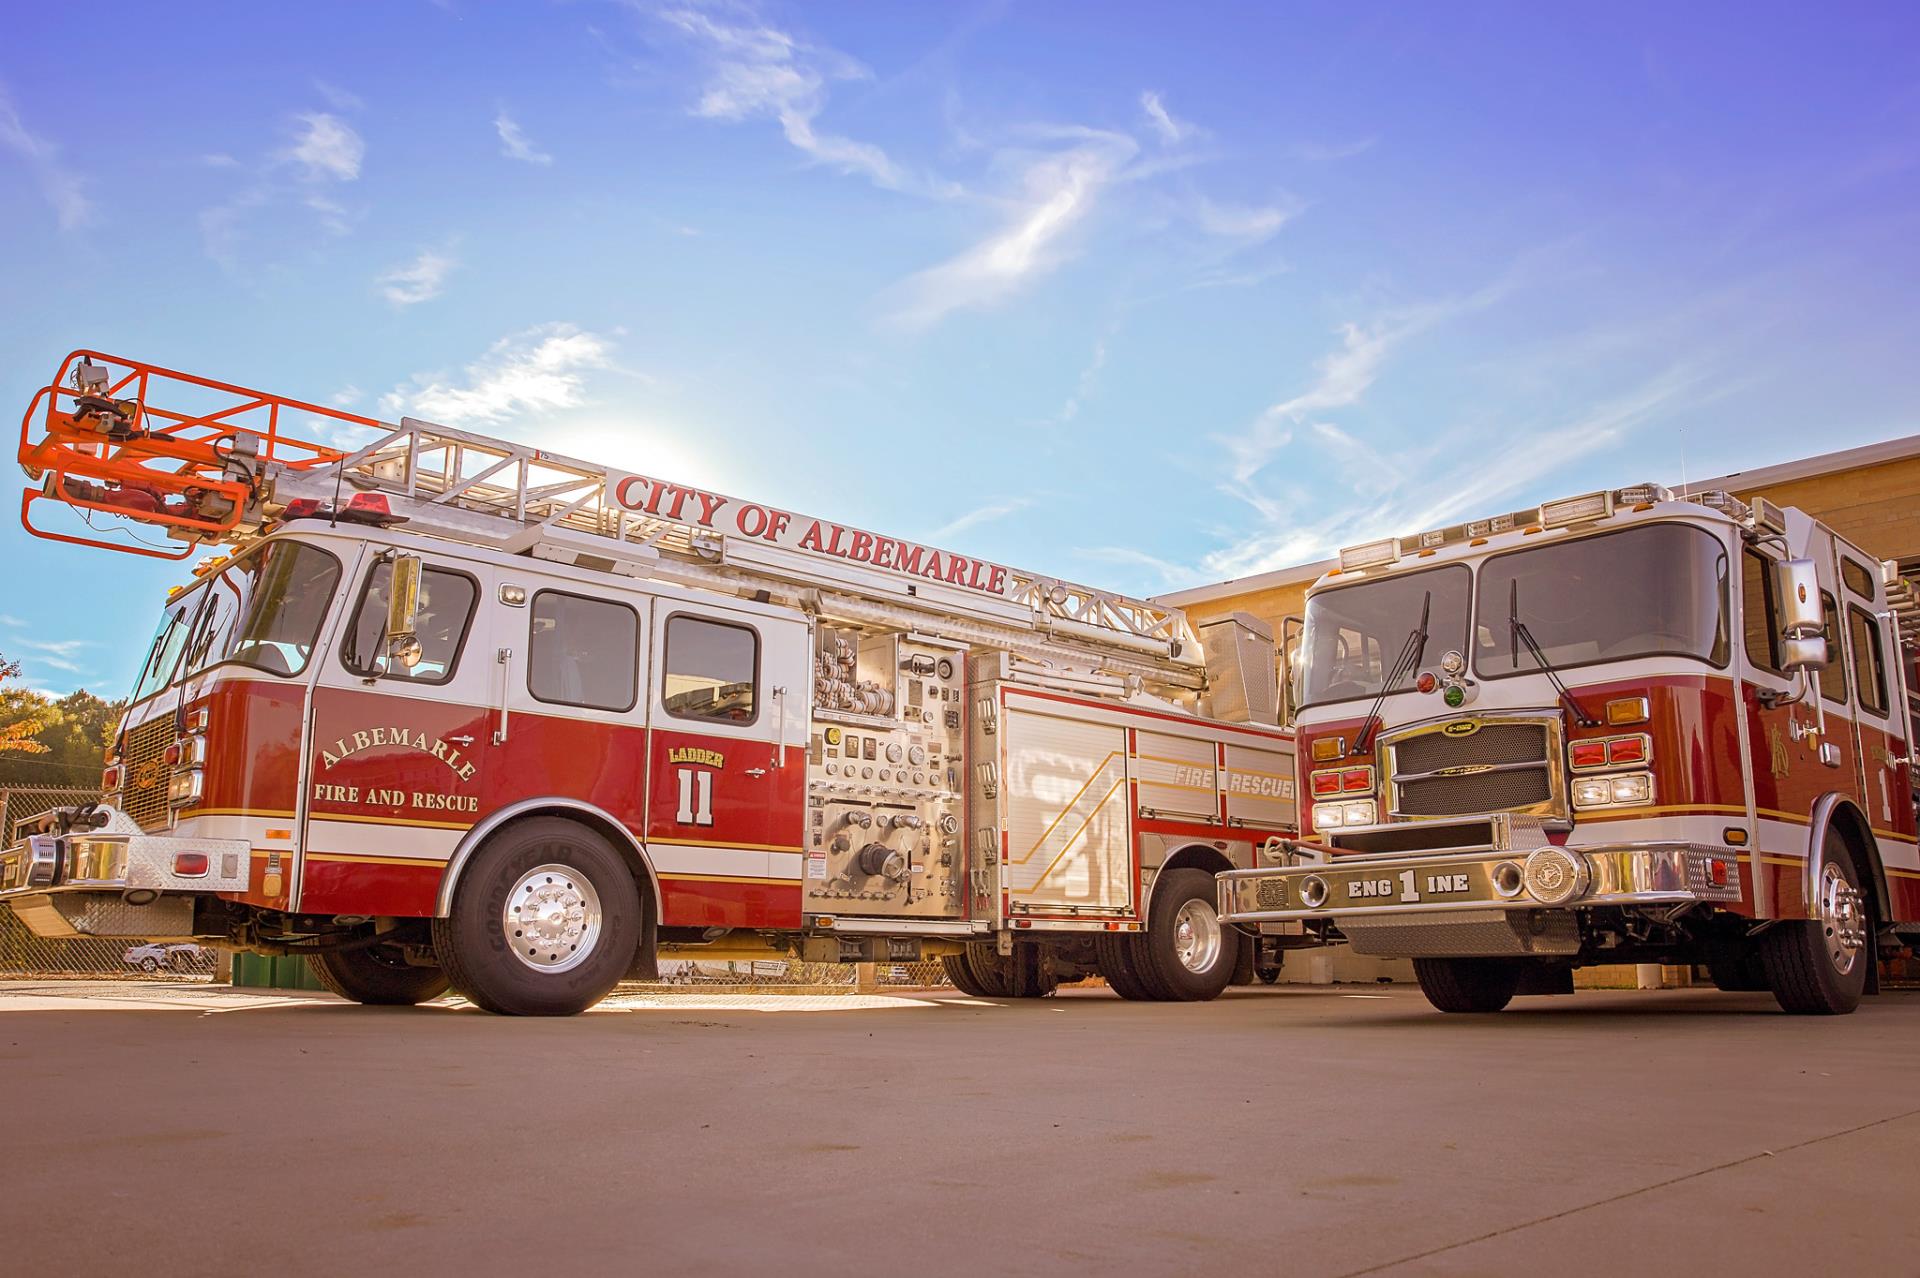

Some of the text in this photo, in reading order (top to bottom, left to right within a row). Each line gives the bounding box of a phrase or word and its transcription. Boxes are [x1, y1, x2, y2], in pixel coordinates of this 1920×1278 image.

[615, 476, 1008, 595] CITY OF ALBEMARLE
[320, 727, 477, 782] ALBEMARLE
[668, 747, 724, 769] LADDER
[314, 784, 478, 812] FIRE AND RESCUE
[676, 768, 713, 826] 11
[1175, 766, 1292, 799] FIRE RESCUE
[1878, 768, 1892, 822] 1
[1348, 869, 1469, 902] ENG 1 INE
